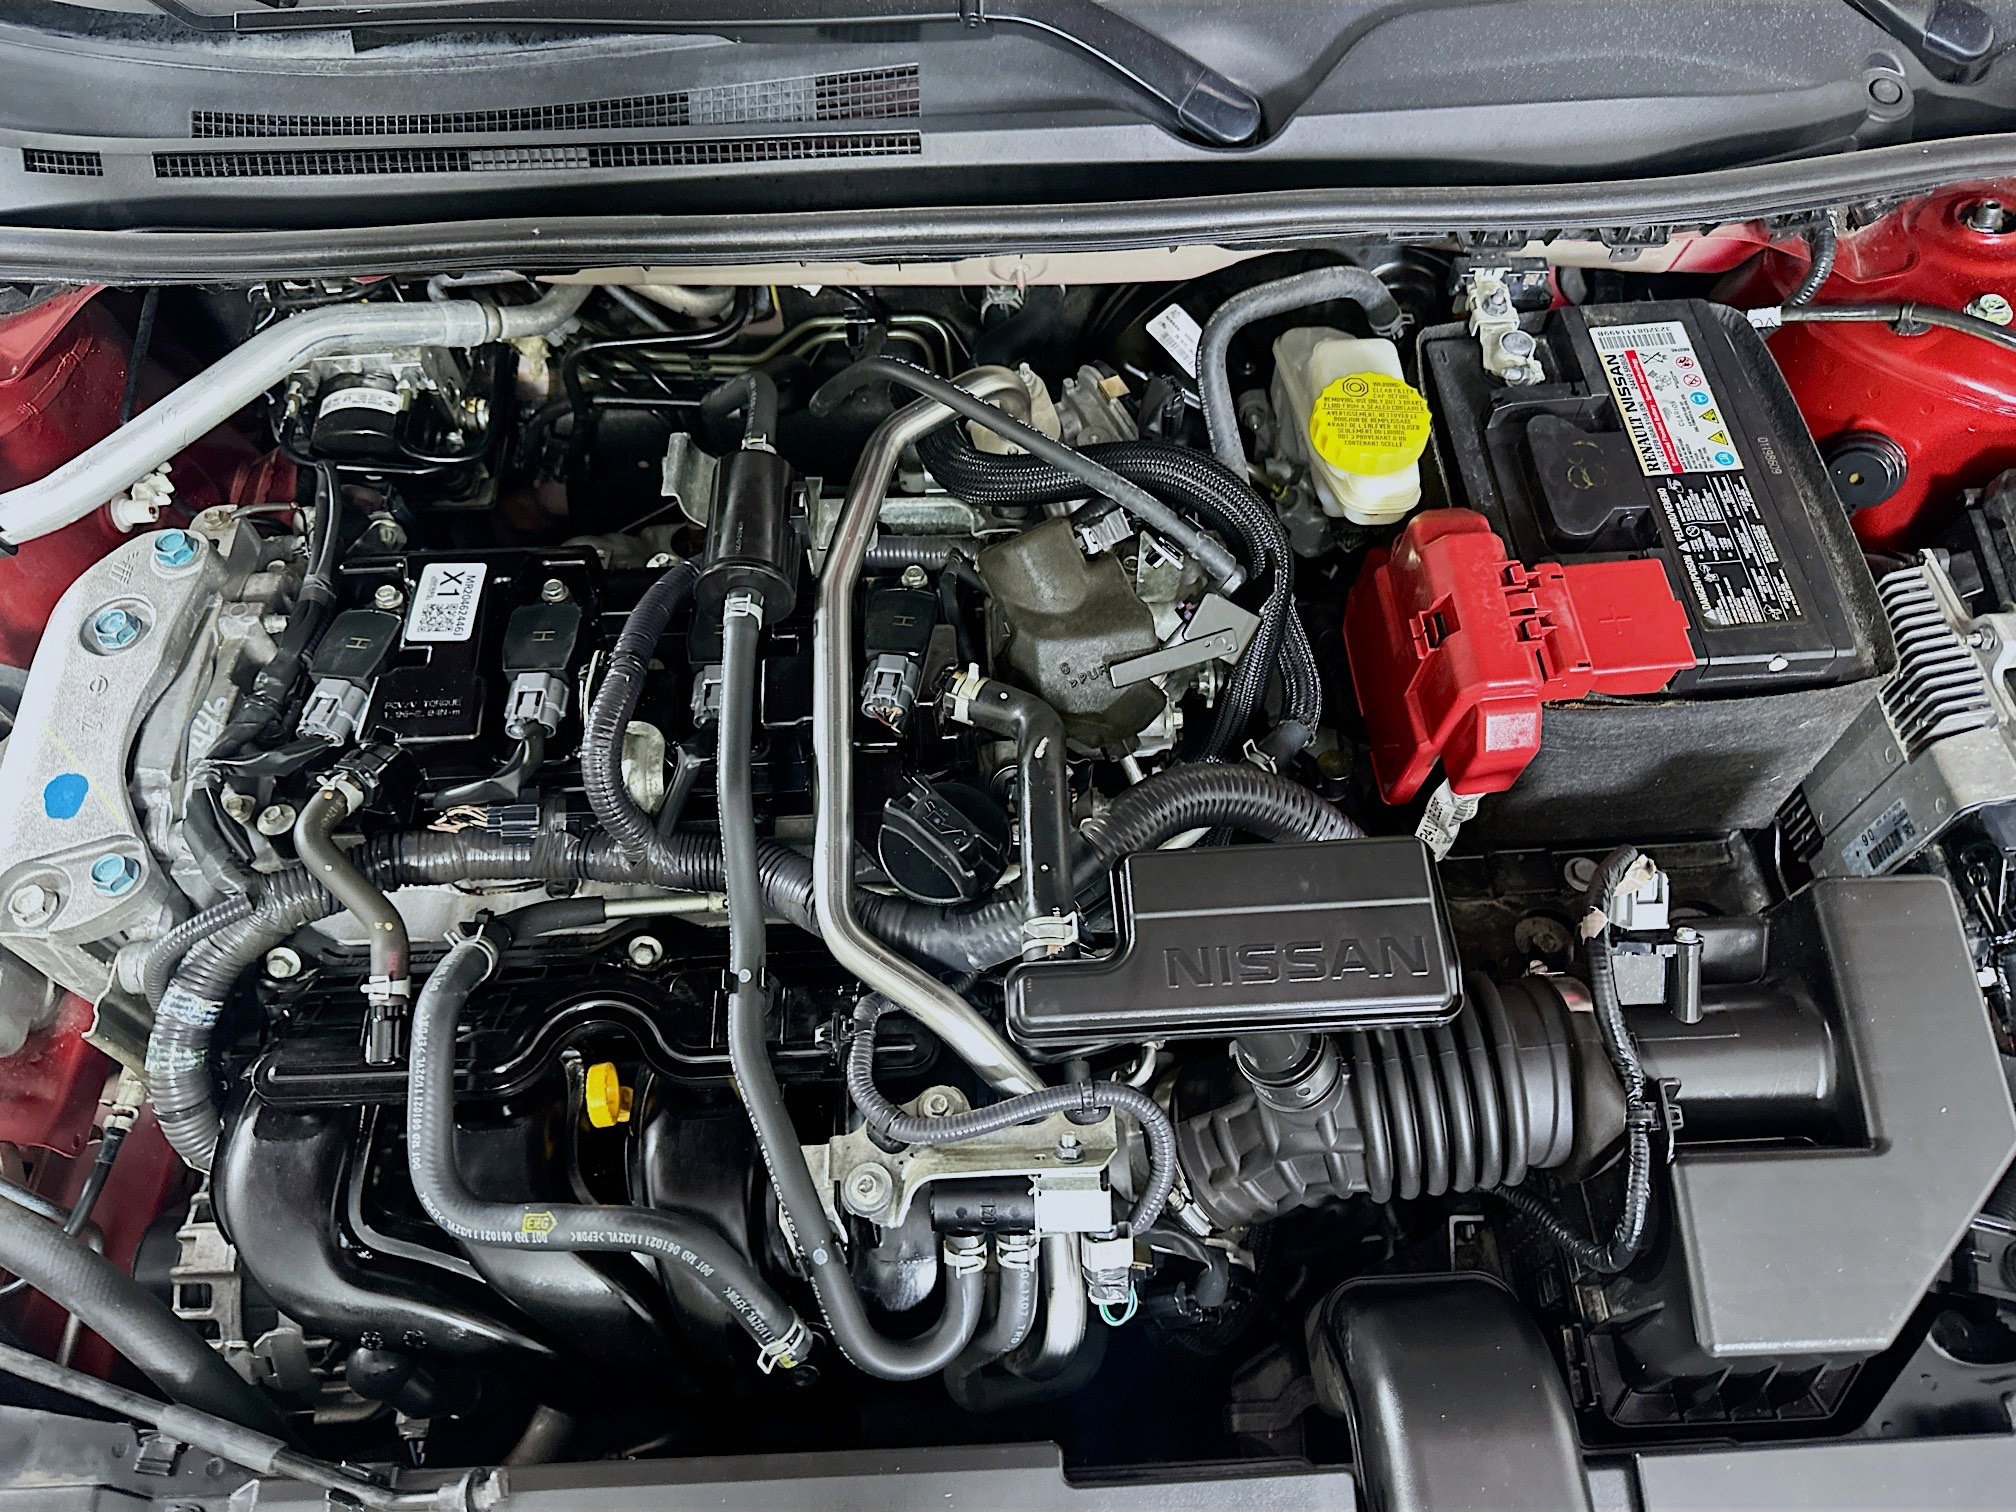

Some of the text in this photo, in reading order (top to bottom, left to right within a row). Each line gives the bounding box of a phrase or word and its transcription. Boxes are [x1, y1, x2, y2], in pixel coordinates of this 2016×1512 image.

[1641, 383, 1652, 400] Special
[1604, 353, 1661, 471] RENAULT NISSAN
[1649, 404, 1660, 420] Battery
[1669, 400, 1684, 426] CLARIOS
[1656, 421, 1668, 441] Flooded
[1663, 441, 1678, 466] Enhanced
[1657, 488, 1685, 542] PELIGRO/VENENO
[440, 571, 465, 595] X1
[1683, 555, 1712, 610] DANGER/POISON
[1164, 935, 1429, 989] NISSAN
